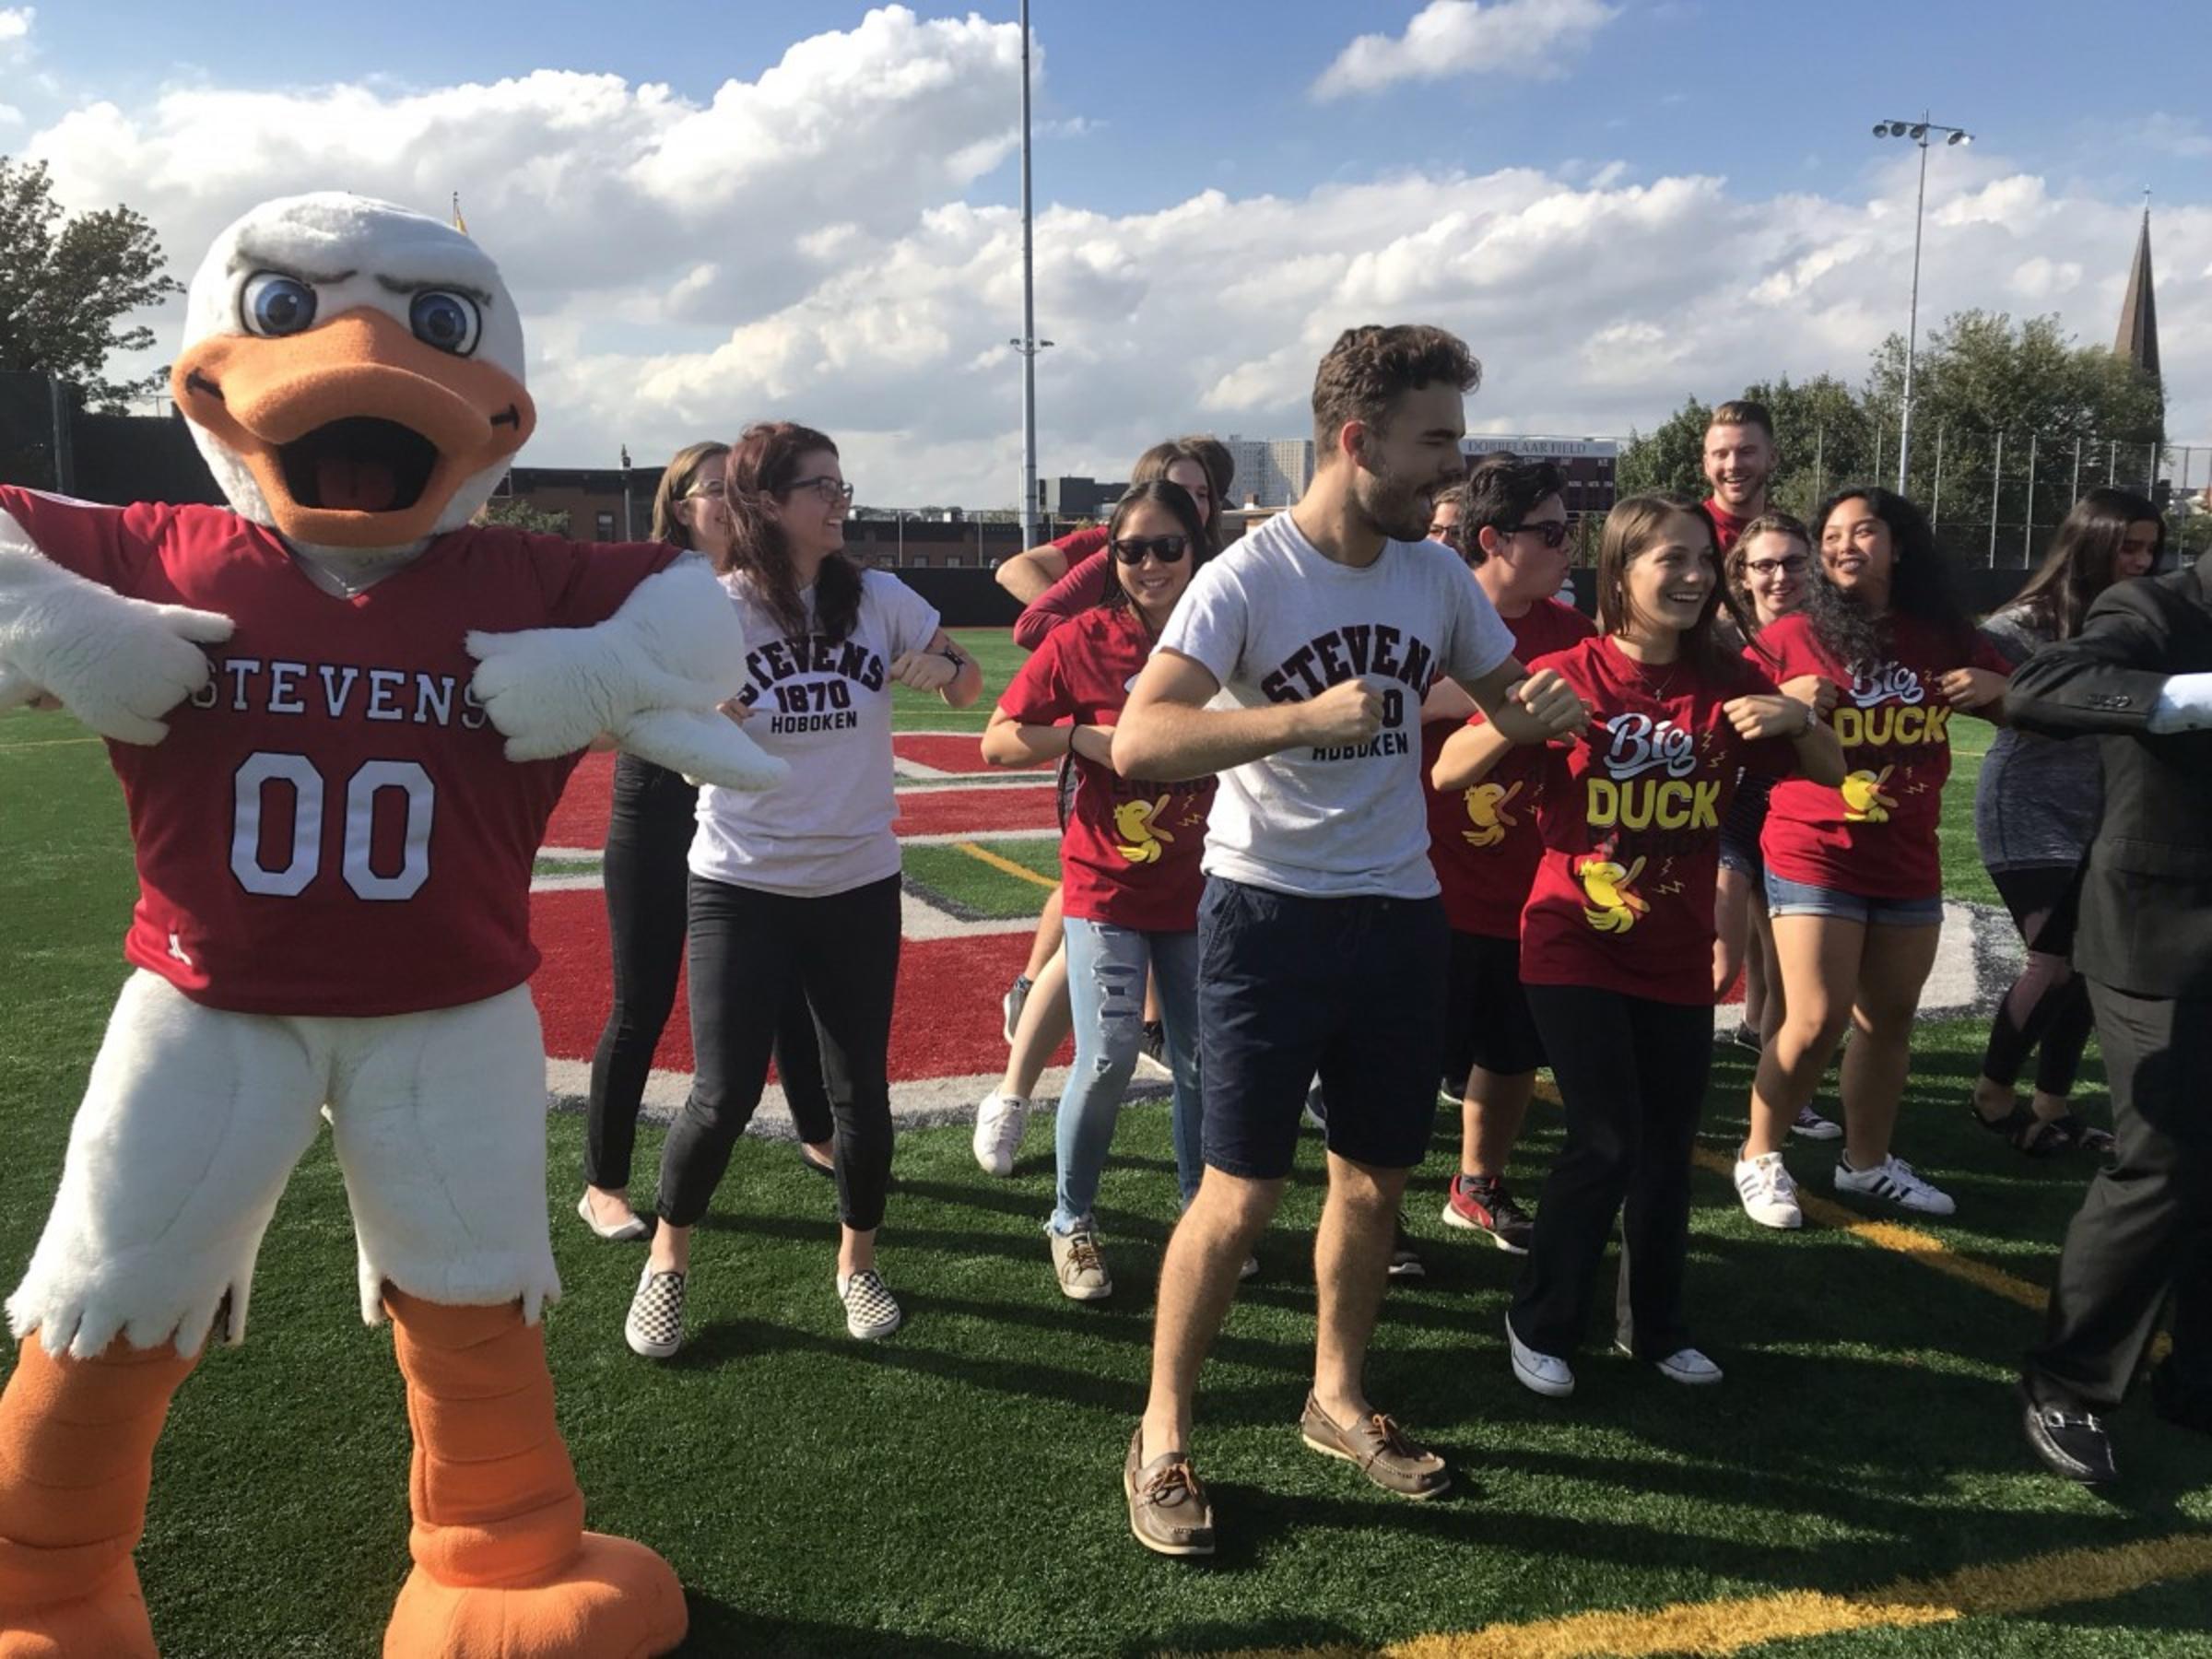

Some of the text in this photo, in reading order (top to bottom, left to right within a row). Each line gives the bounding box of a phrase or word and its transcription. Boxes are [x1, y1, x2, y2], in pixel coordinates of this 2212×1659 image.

[1551, 441, 1586, 453] FIELD
[774, 679, 851, 713] 1870
[1844, 658, 1924, 708] Big
[771, 712, 857, 734] HOBOKEN
[1833, 706, 1951, 747] DUCK
[1604, 712, 1697, 780] Big
[229, 751, 435, 900] 00
[1586, 777, 1721, 831] DUCK
